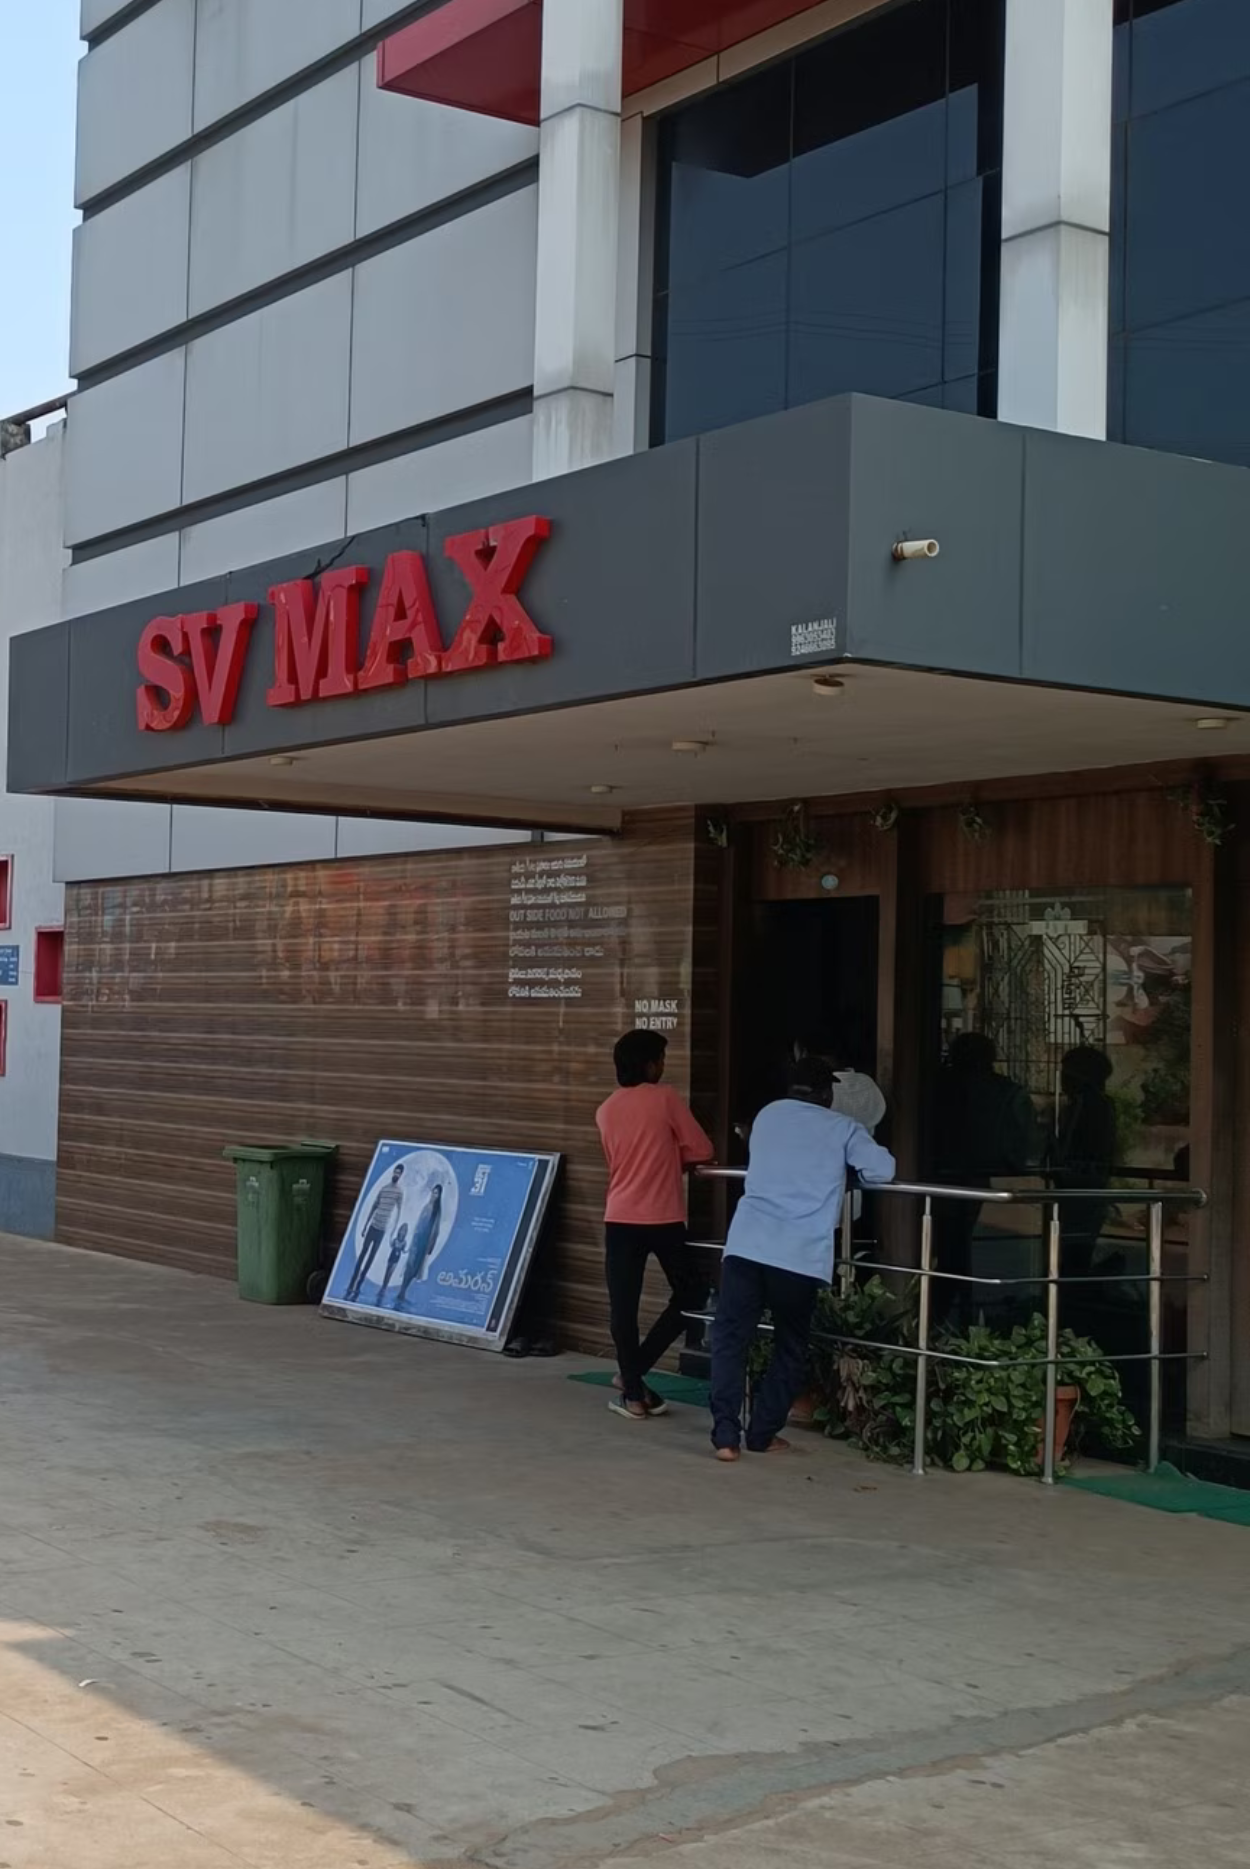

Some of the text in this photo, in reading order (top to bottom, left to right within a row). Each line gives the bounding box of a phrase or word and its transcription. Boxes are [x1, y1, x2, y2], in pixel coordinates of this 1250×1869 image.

[137, 515, 554, 732] SV MAX
[526, 909, 544, 921] SIDE
[545, 907, 567, 921] FOOD
[634, 999, 678, 1013] NO MASK
[634, 1016, 678, 1030] NO ENTRY
[437, 1269, 498, 1292] అమరన్
